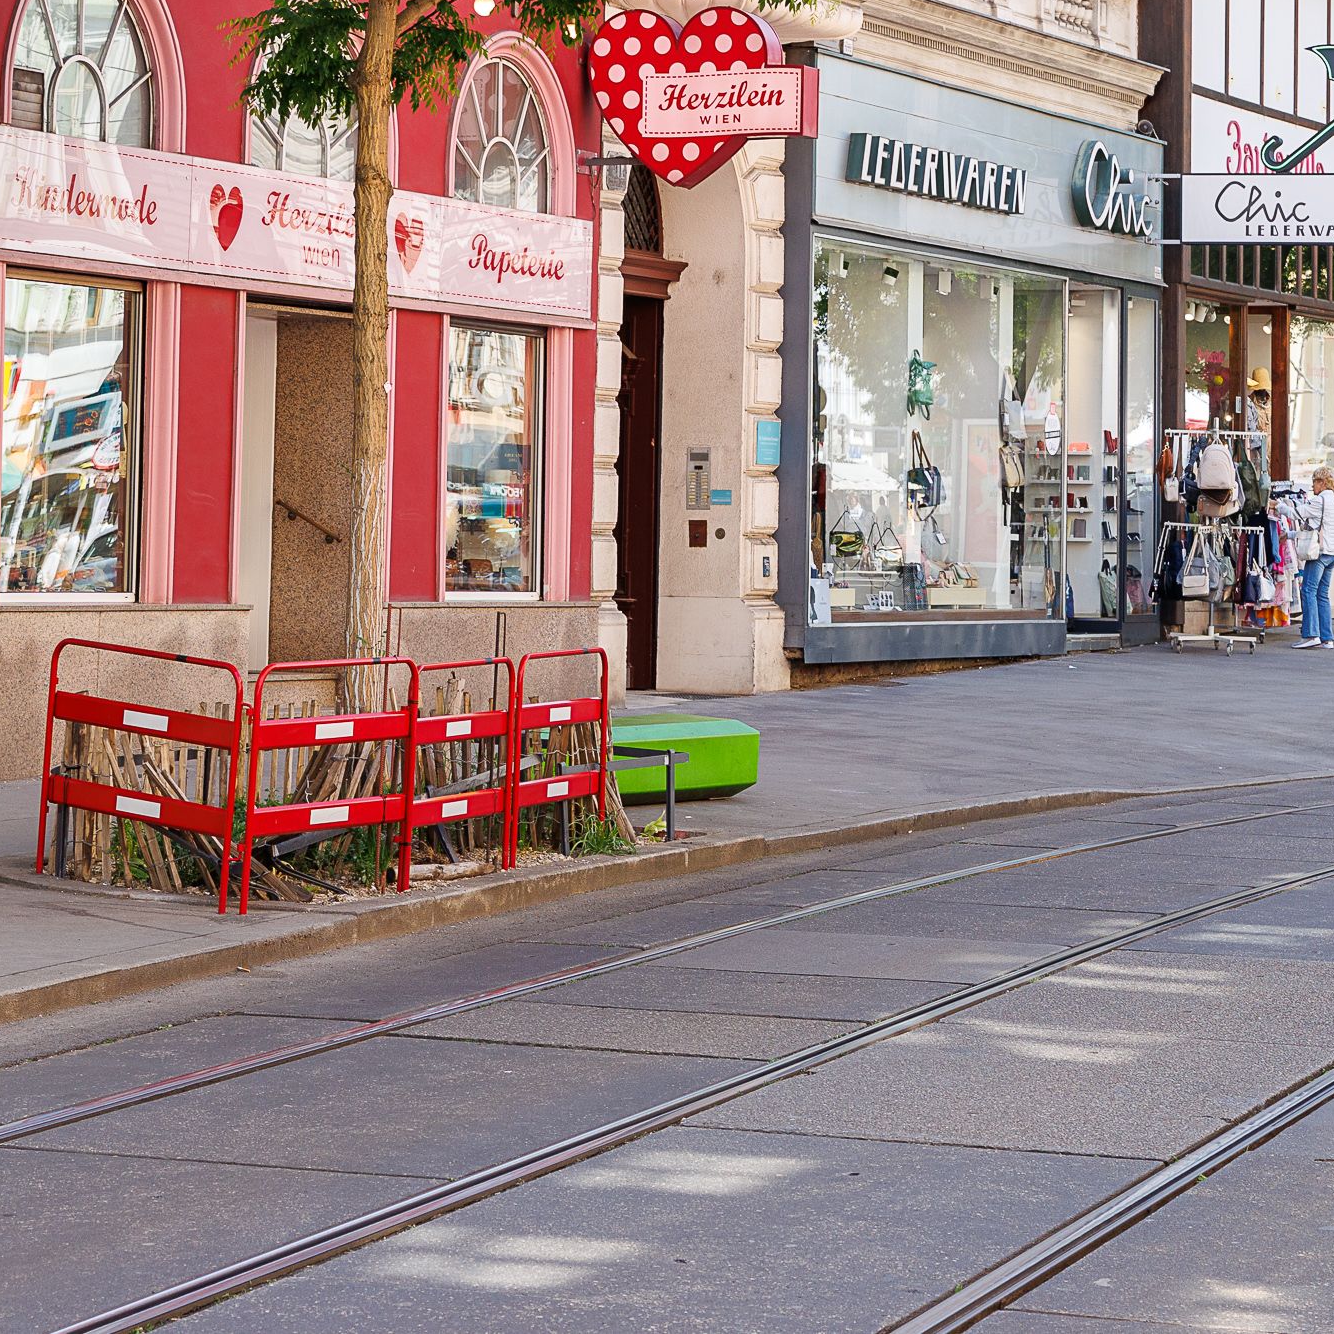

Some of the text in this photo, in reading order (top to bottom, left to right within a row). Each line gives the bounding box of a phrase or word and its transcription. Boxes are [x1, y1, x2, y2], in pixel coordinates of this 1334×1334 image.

[658, 80, 785, 111] Herzilein
[699, 113, 741, 125] WIEN
[11, 164, 158, 226] Kindermode
[857, 133, 1028, 215] LEDERWAREN
[1079, 140, 1154, 237] Chic
[1214, 180, 1310, 223] Chic
[261, 190, 355, 238] Herzile
[303, 243, 341, 268] wien
[468, 233, 565, 284] Papeterie
